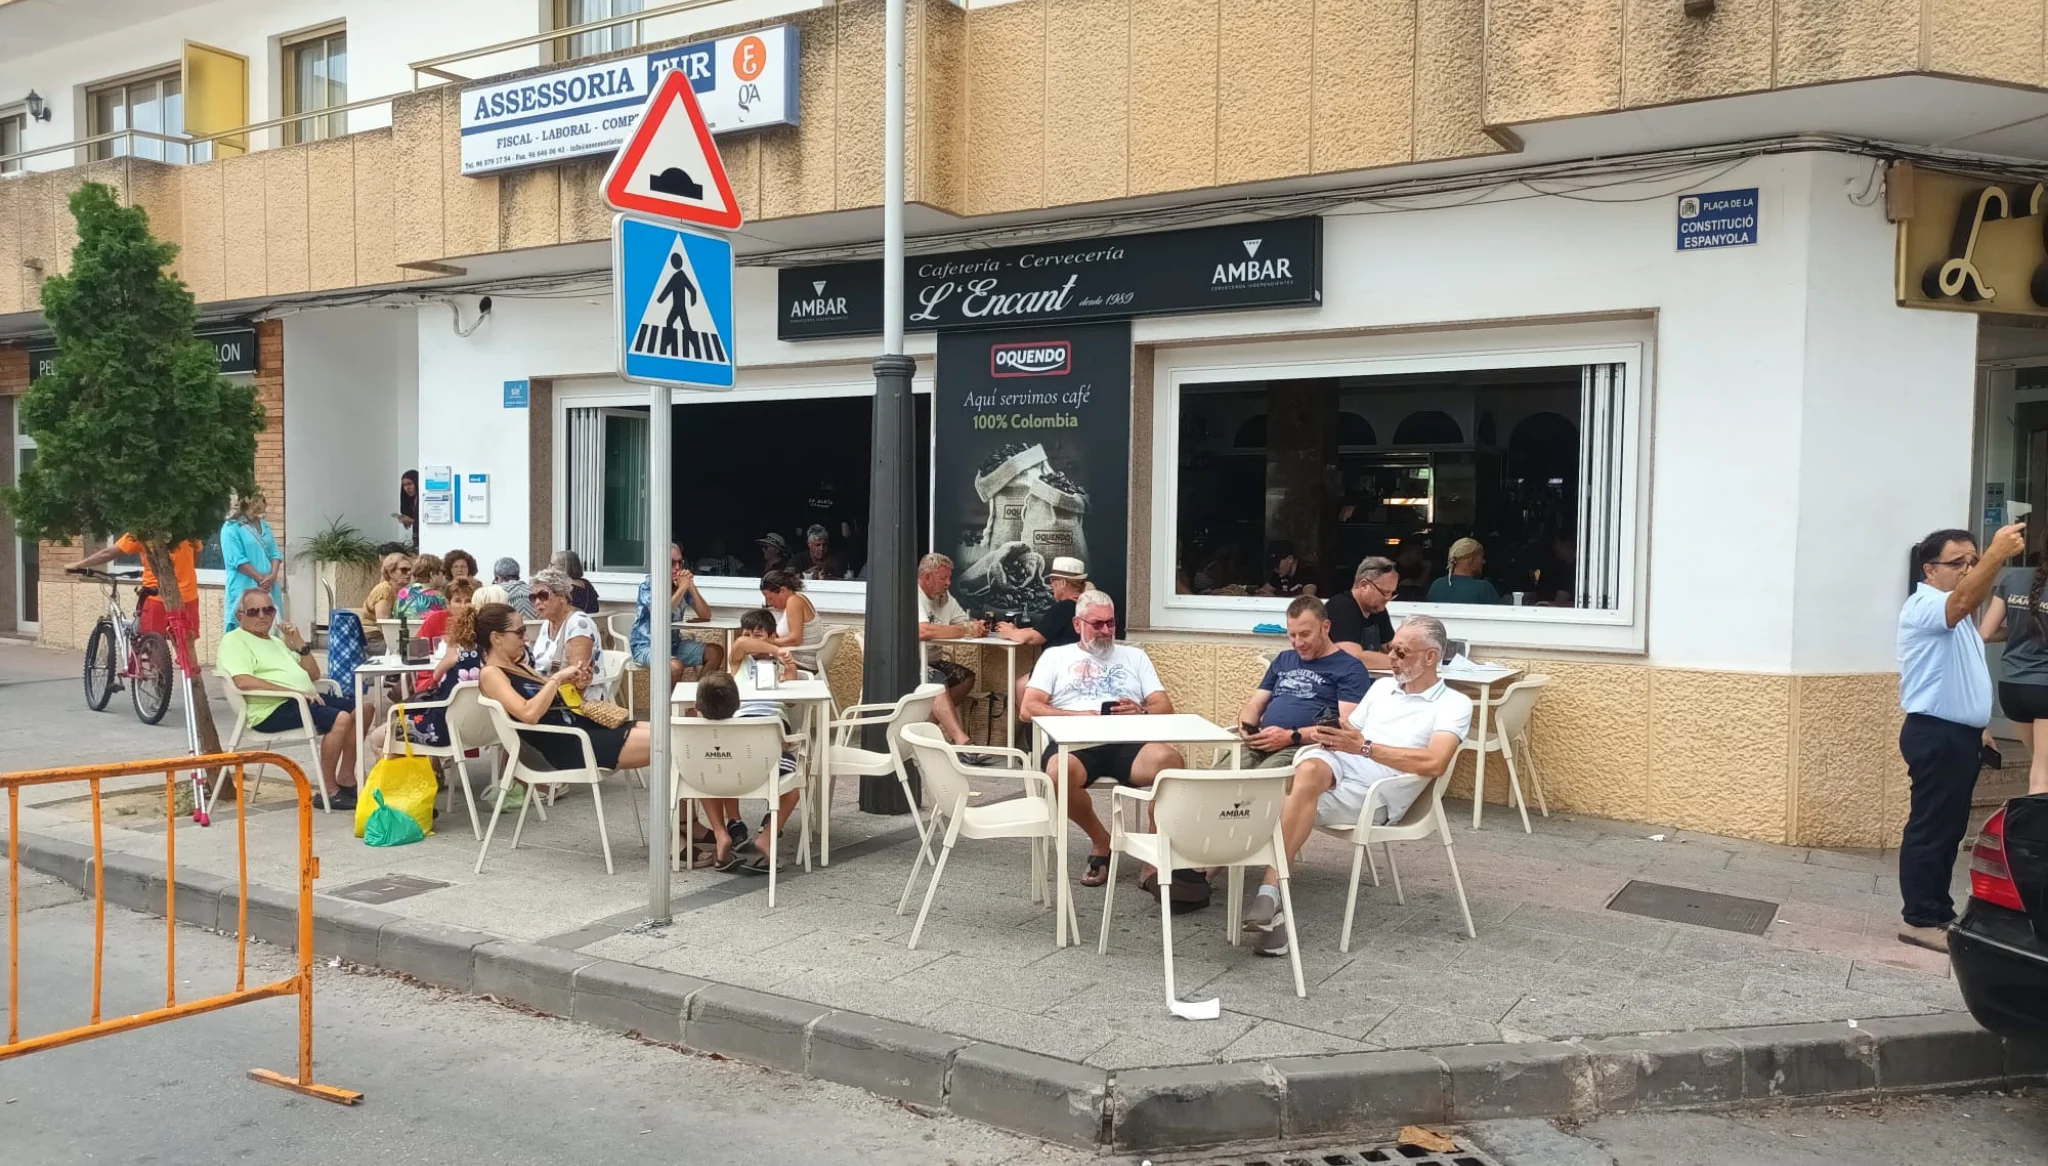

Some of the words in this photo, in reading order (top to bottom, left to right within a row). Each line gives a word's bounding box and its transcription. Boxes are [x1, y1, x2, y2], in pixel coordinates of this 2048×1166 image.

[474, 67, 635, 120] ASSESSORIA
[497, 134, 533, 149] FISCAL
[542, 122, 592, 141] LABORAL
[602, 113, 639, 131] COMP
[1703, 200, 1729, 211] PLAÇA
[1731, 199, 1742, 208] DE
[1743, 198, 1754, 207] LA
[1681, 214, 1754, 234] CONSTITUCIÓ
[1684, 232, 1749, 248] ESPANYOLA
[918, 257, 1000, 279] Cafetería
[1019, 246, 1124, 269] Cervecería
[1211, 258, 1293, 284] AMBAR
[790, 297, 848, 317] AMBAR
[996, 348, 1066, 369] OQUENDO
[963, 388, 998, 411] Aquí
[1000, 389, 1058, 407] servimos
[1062, 384, 1092, 409] café
[973, 414, 1008, 429] 100%
[1010, 412, 1079, 429] Colombia
[1035, 533, 1071, 541] OQUENDO
[1219, 809, 1251, 818] AMBAR
